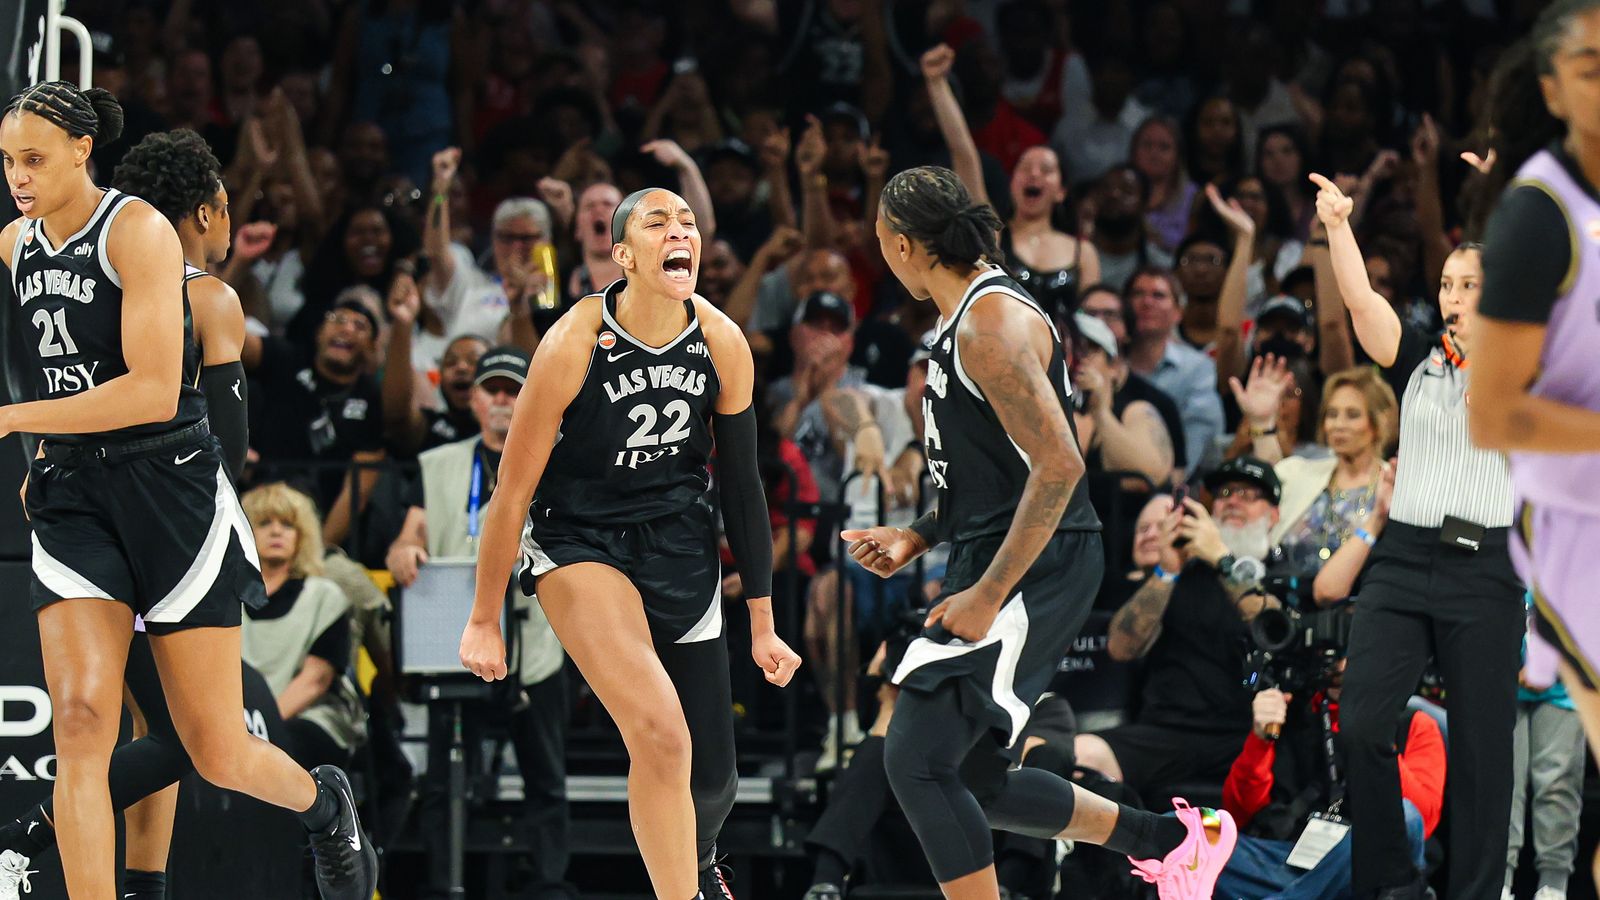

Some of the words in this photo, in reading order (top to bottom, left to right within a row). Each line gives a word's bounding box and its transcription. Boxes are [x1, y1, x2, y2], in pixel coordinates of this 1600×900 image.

[74, 242, 95, 258] ally
[18, 270, 43, 307] LAS
[44, 269, 97, 304] VEGAS
[31, 308, 79, 358] 21
[603, 368, 647, 404] LAS
[647, 364, 707, 397] VEGAS
[626, 399, 692, 449] 22
